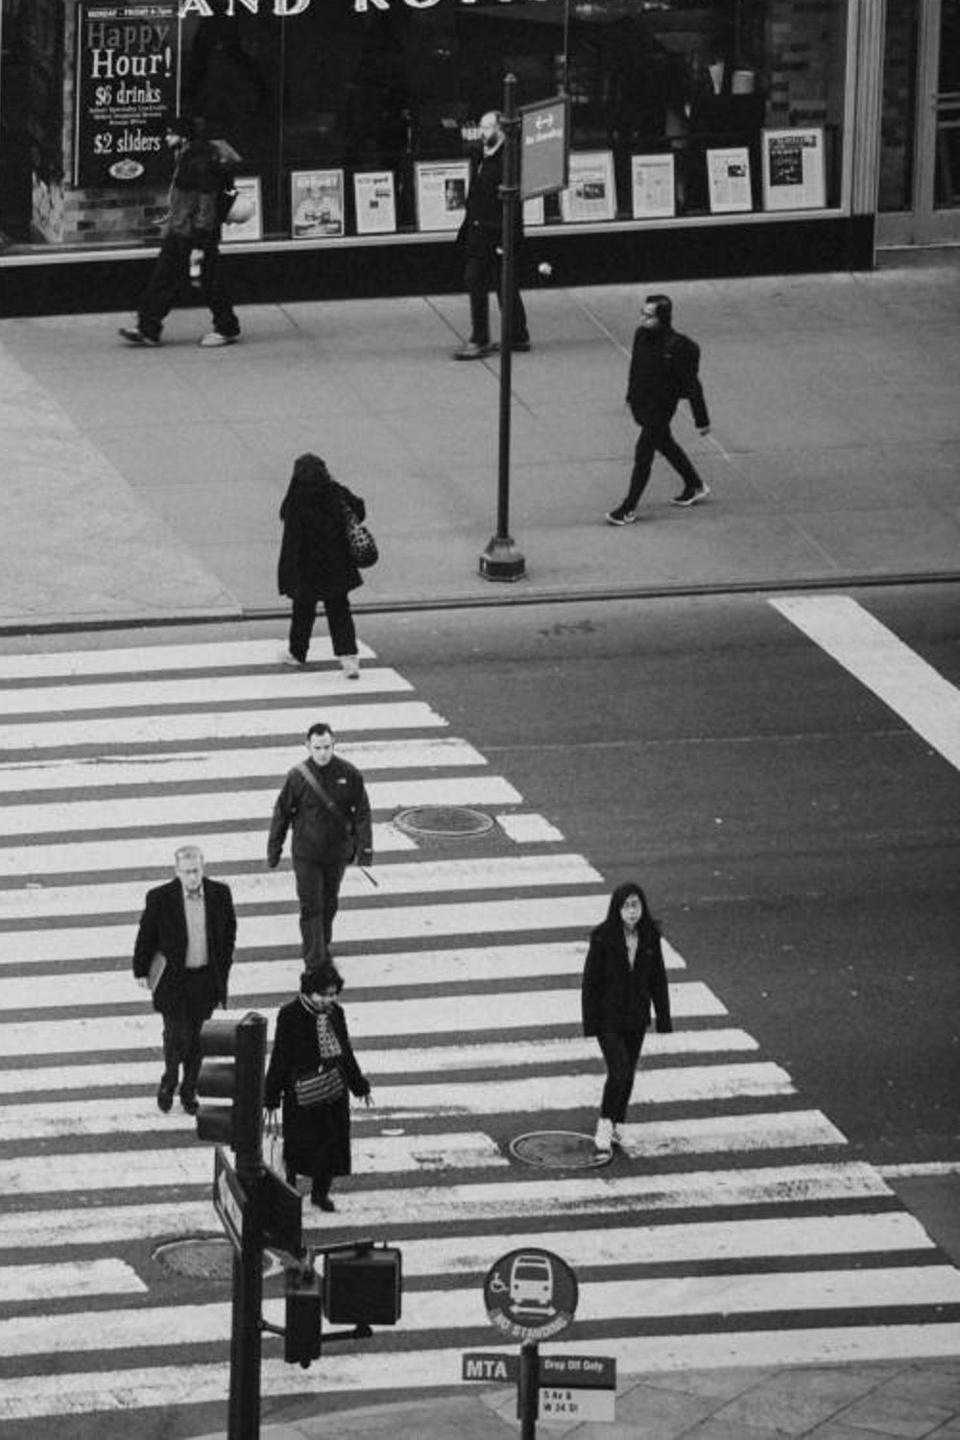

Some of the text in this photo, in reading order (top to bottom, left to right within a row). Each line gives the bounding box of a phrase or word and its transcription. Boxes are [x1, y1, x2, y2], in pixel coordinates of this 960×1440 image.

[87, 23, 171, 54] Happy
[90, 45, 172, 79] Hour!
[116, 79, 162, 105] drinks
[93, 127, 162, 155] $2 sliders
[466, 1360, 508, 1378] MTA
